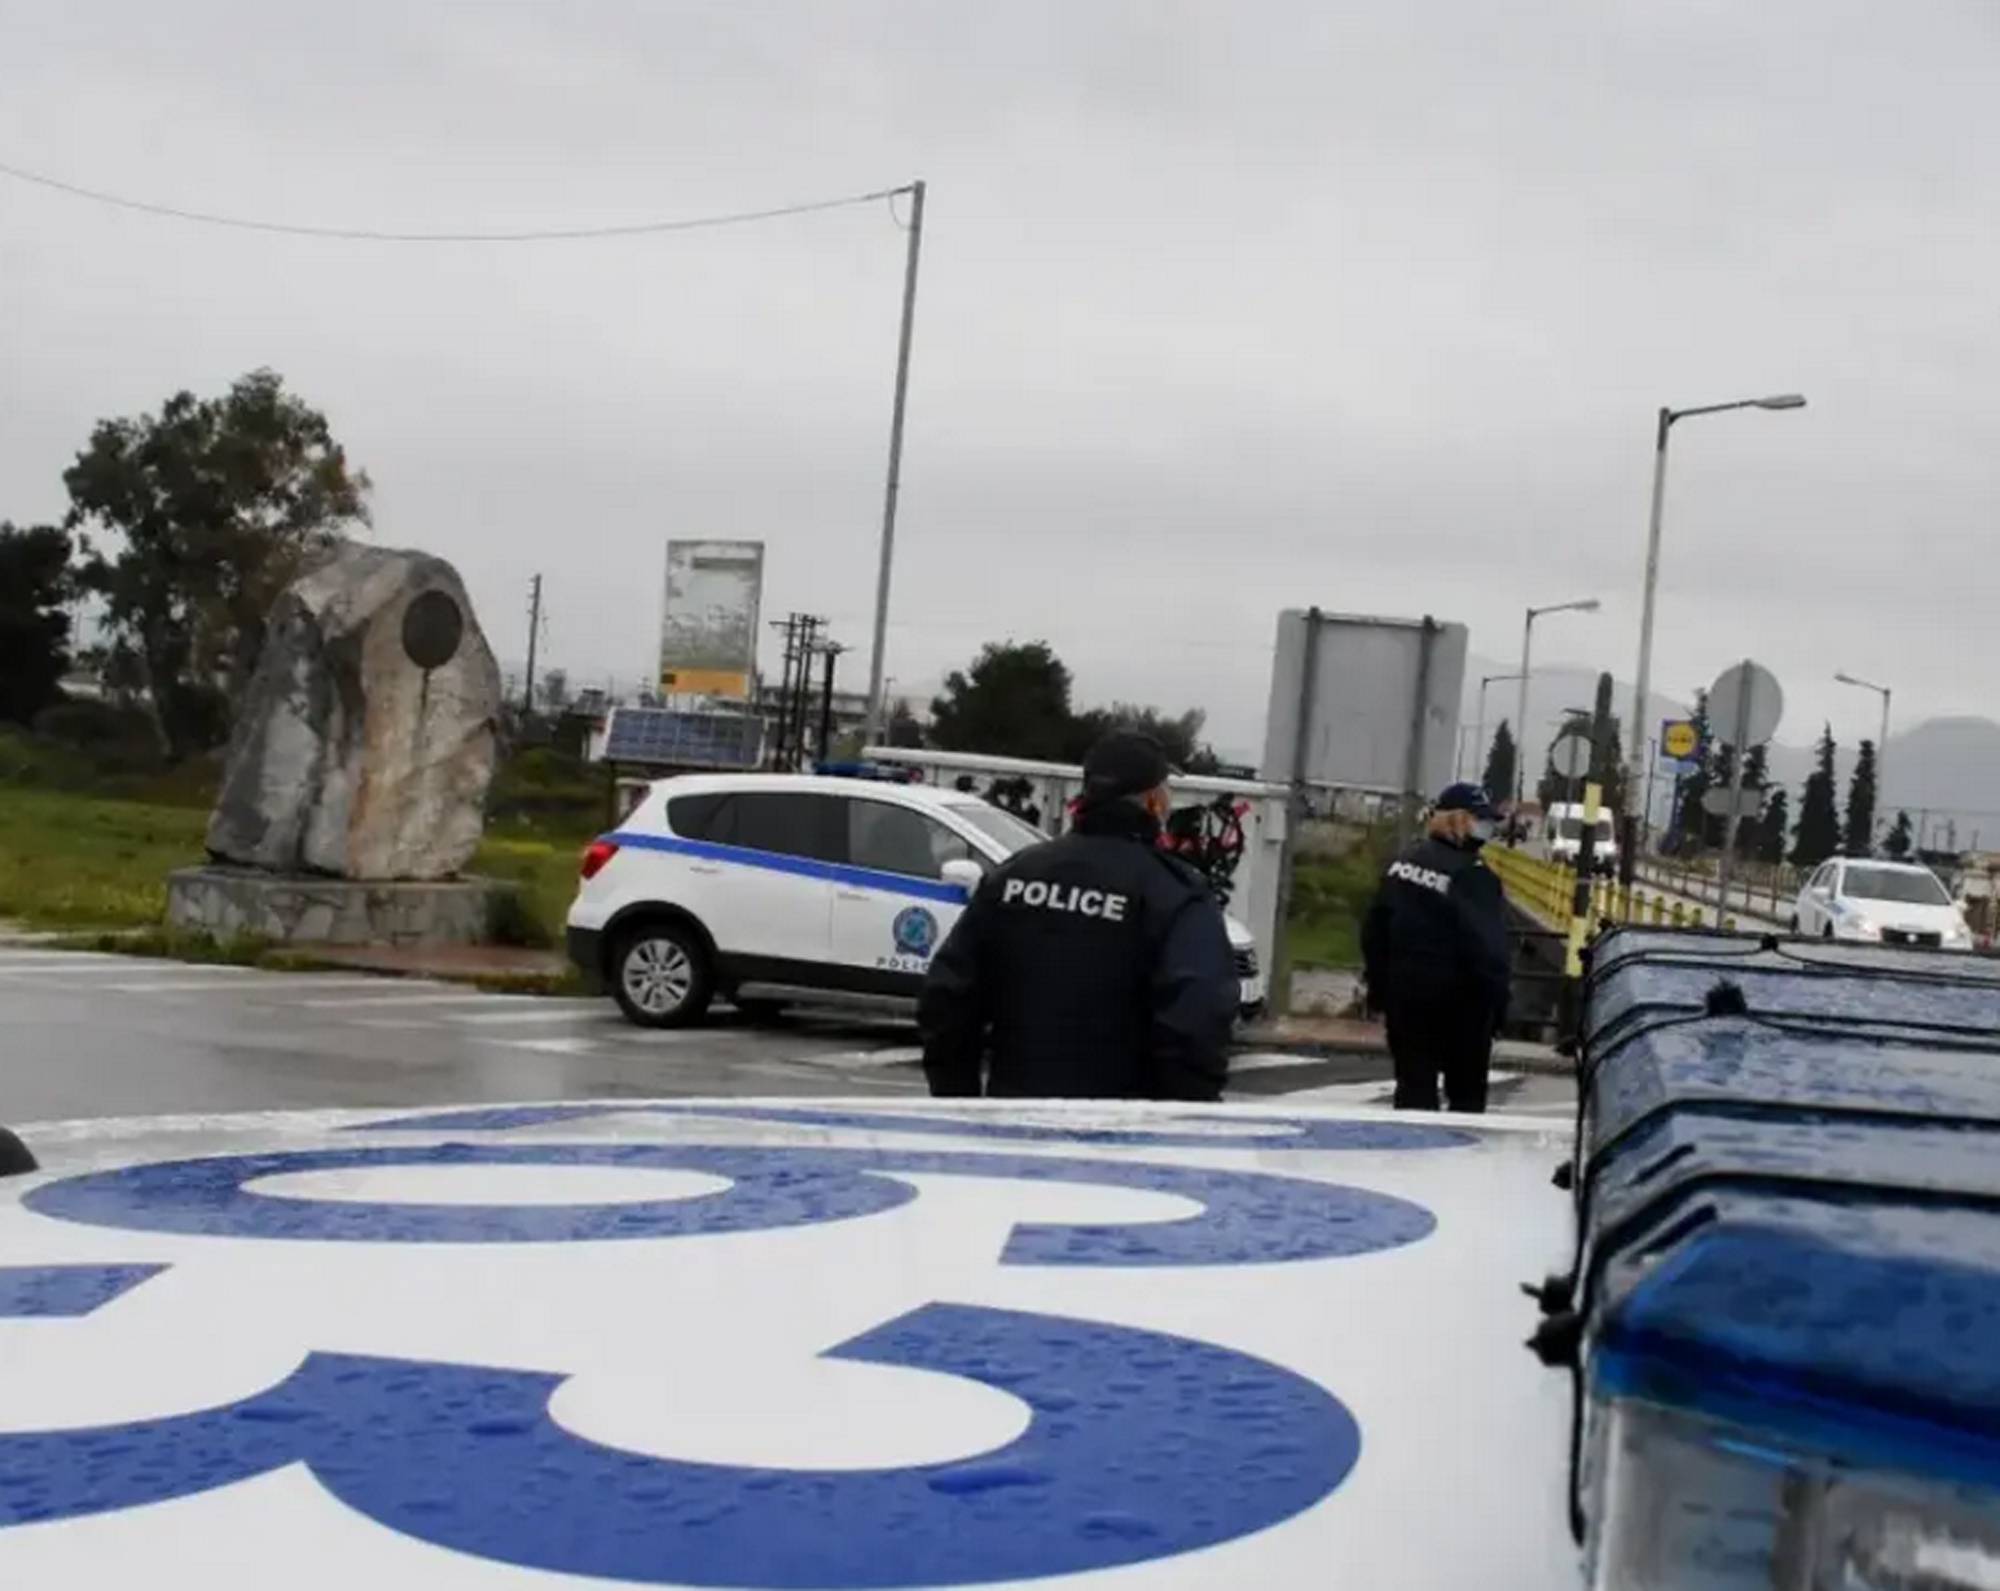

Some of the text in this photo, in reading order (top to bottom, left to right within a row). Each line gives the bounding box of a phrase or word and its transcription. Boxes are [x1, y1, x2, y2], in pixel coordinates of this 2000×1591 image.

[1387, 861, 1451, 894] POLICE
[1002, 878, 1128, 921] POLICE
[876, 956, 930, 972] POLIC
